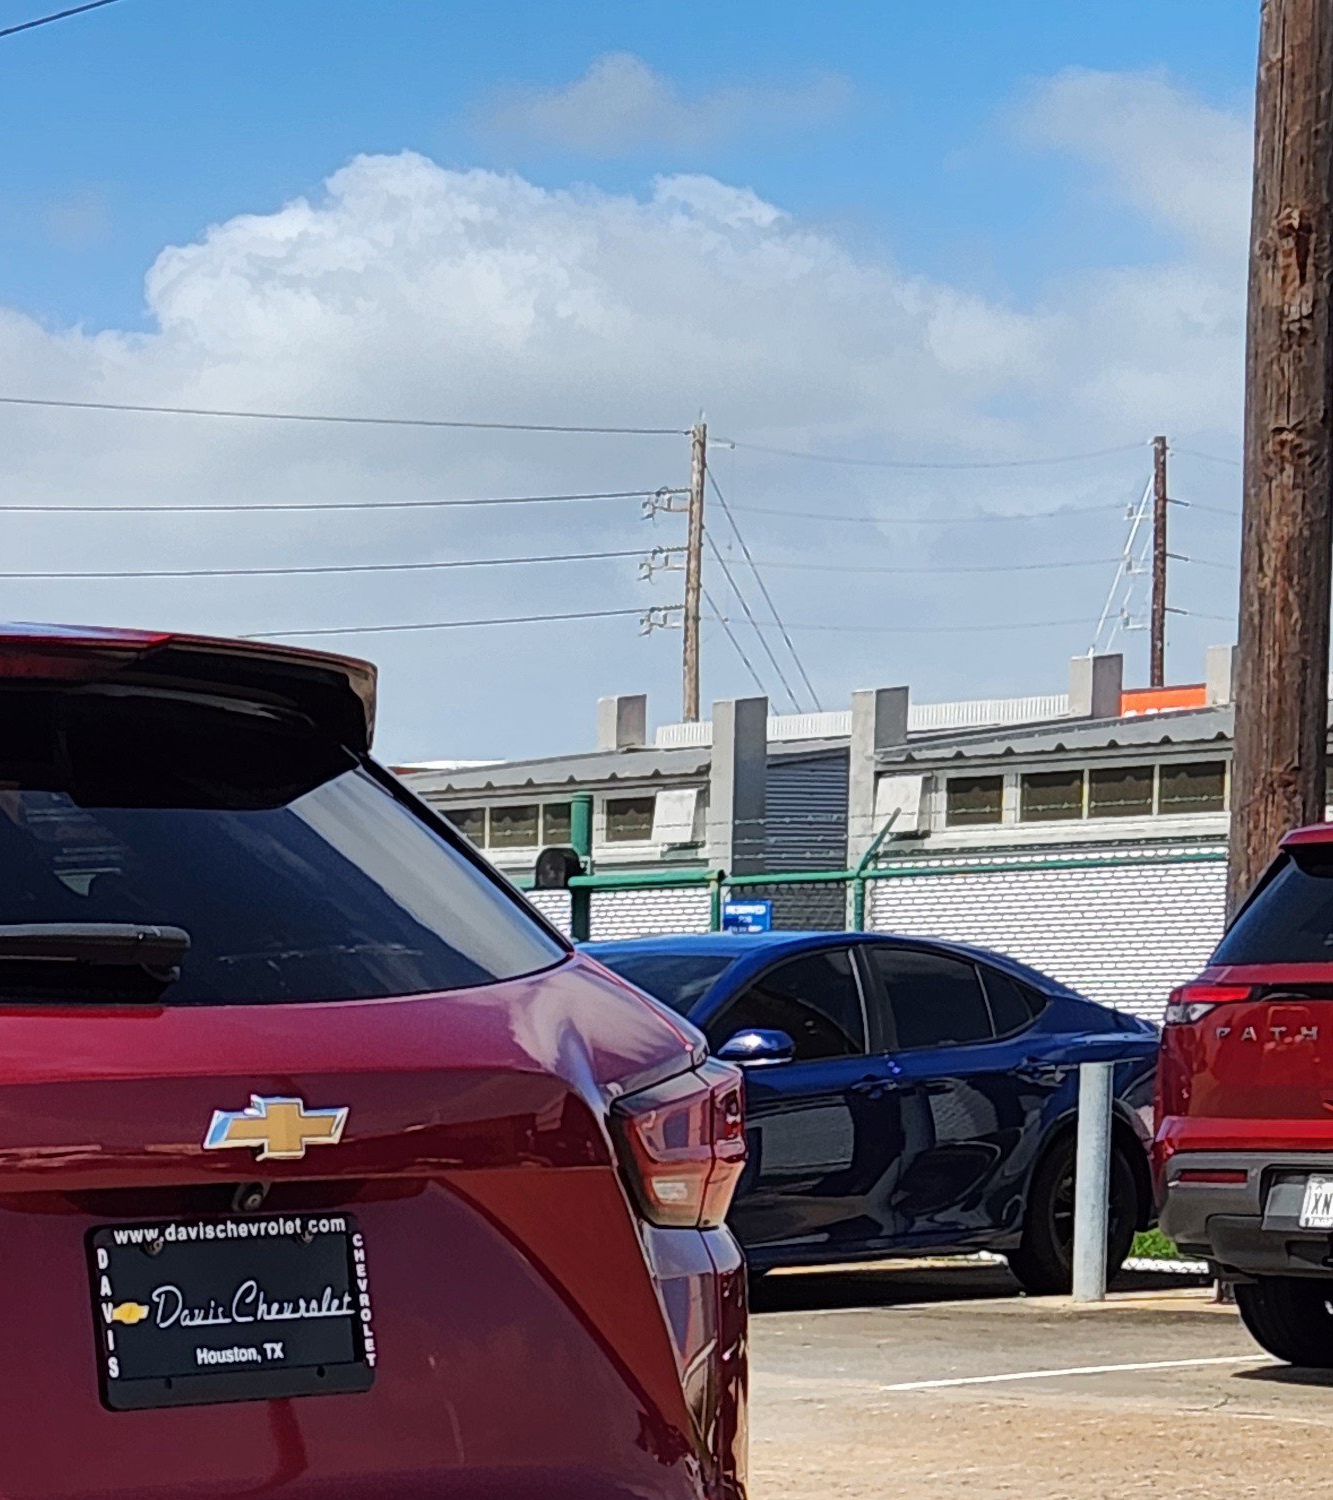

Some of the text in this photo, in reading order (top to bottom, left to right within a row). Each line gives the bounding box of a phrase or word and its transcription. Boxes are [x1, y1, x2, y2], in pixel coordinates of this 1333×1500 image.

[1215, 1026, 1318, 1041] PATH
[114, 1217, 346, 1245] www.davischevroletcom
[97, 1248, 119, 1378] DAVIS
[152, 1280, 356, 1328] Davis Chevrolet
[352, 1233, 376, 1367] CHEVROLET
[196, 1342, 285, 1365] Houston, TX
